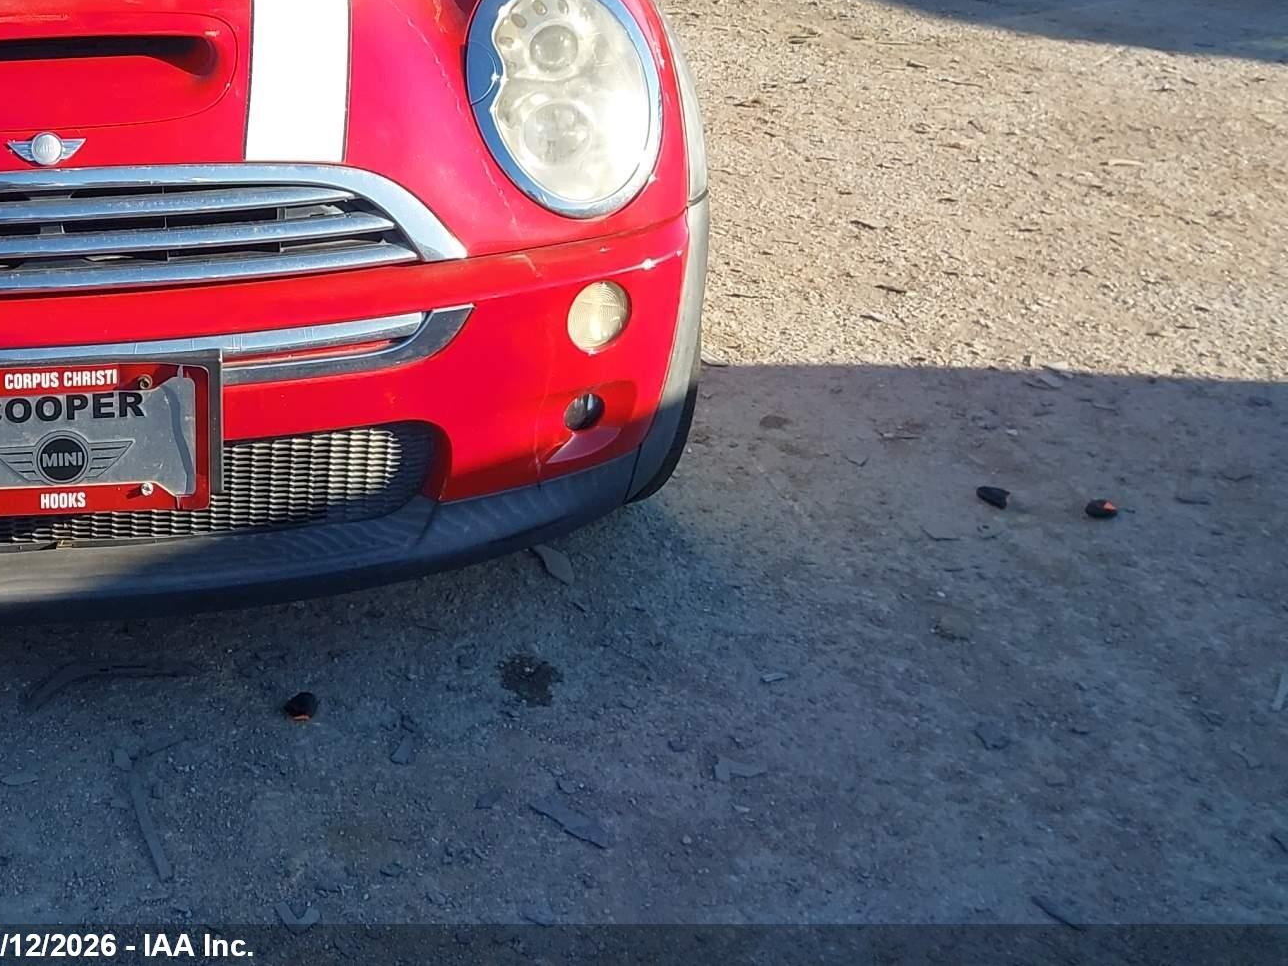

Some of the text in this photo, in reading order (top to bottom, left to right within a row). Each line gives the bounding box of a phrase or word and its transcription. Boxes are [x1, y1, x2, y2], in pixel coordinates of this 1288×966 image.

[4, 369, 118, 390] CORPUS CHRISTI
[42, 452, 82, 468] MINI
[40, 492, 86, 509] HOOKS
